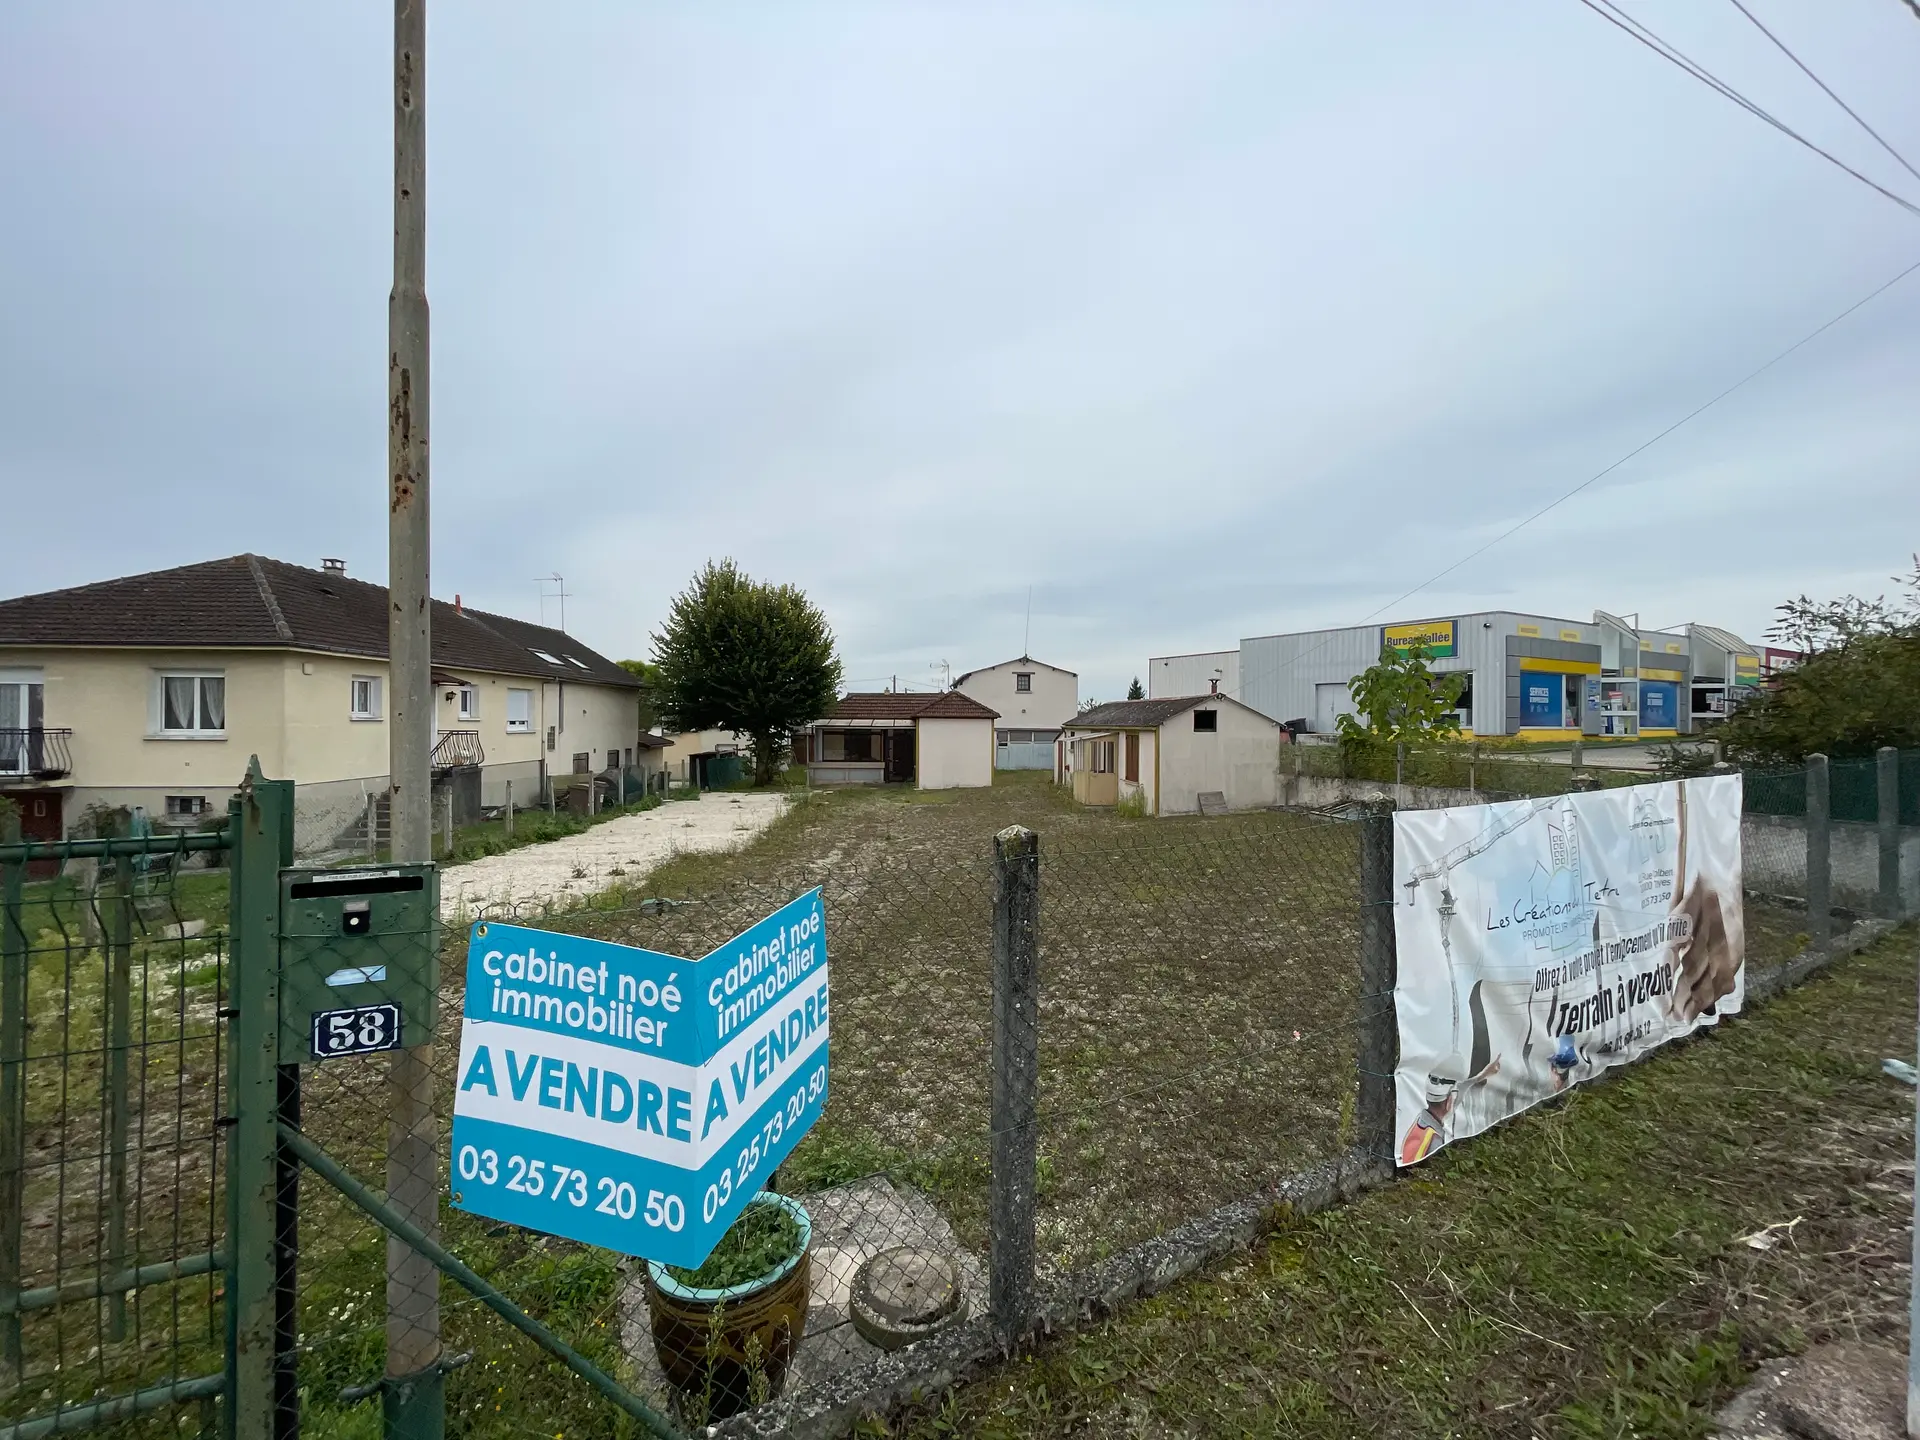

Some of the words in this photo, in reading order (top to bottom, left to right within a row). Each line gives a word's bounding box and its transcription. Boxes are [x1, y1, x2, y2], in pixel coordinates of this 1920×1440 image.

[1387, 635, 1420, 647] Burea
[1487, 907, 1510, 931] Les
[1513, 898, 1571, 924] Créations
[1522, 922, 1569, 941] PROMOTEUR
[483, 948, 608, 996] cabinet
[619, 972, 682, 1013] noé
[709, 926, 786, 1006] cabinet
[790, 901, 819, 949] noé
[1562, 961, 1568, 985] à
[492, 979, 668, 1047] immobilier
[718, 942, 815, 1039] immobilier
[1556, 984, 1613, 1038] Terrain
[1618, 974, 1626, 1014] à
[1628, 962, 1672, 1008] vendre
[329, 1012, 385, 1050] 58
[701, 1077, 729, 1142] A
[730, 983, 828, 1105] VENDRE
[460, 1045, 498, 1097] A
[505, 1049, 692, 1143] VENDRE
[703, 1168, 732, 1224] 03
[736, 1134, 760, 1190] 25
[763, 1110, 783, 1157] 73
[785, 1086, 806, 1131] 20
[808, 1064, 825, 1104] 50
[459, 1145, 499, 1185] 03
[505, 1155, 544, 1196] 25
[550, 1165, 587, 1207] 73
[595, 1177, 636, 1220] 20
[643, 1194, 685, 1232] 50
